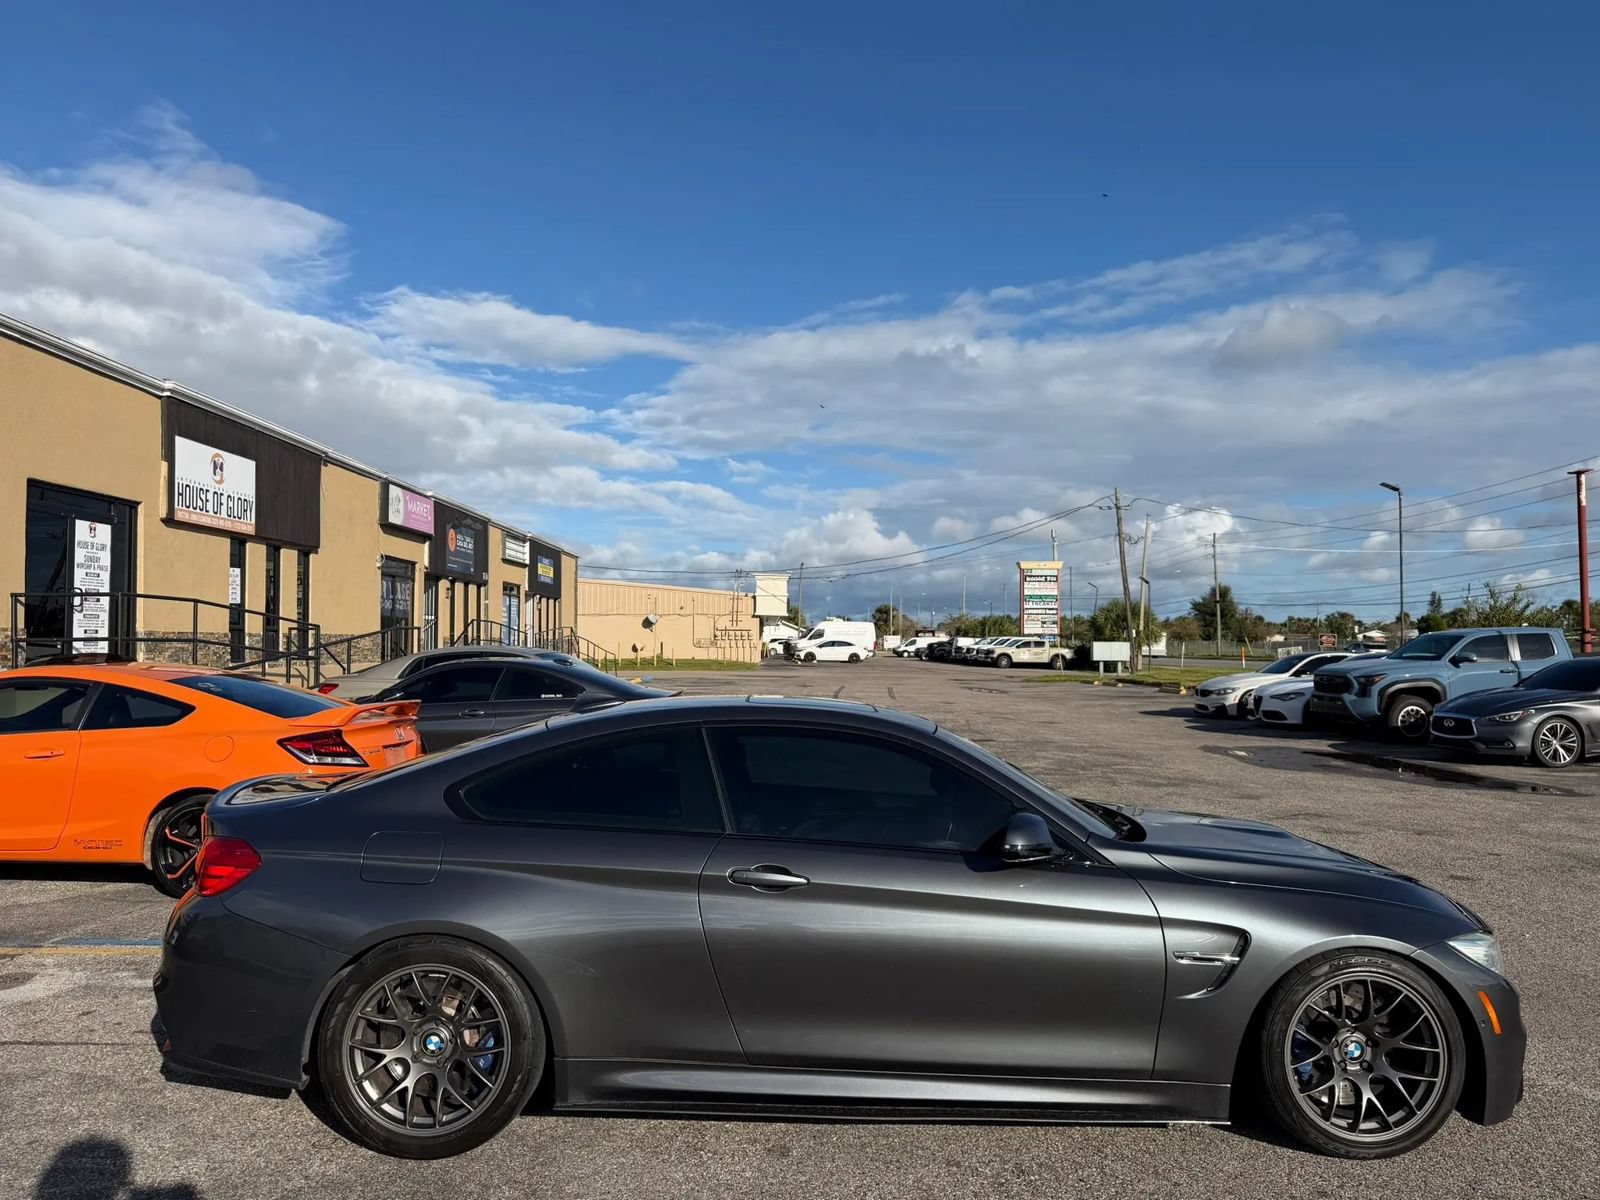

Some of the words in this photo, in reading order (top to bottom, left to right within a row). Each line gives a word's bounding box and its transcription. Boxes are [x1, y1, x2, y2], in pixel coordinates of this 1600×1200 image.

[177, 481, 210, 513] HOUSE
[213, 491, 224, 516] OF
[226, 494, 254, 522] GLORY
[407, 495, 431, 520] MARKET
[77, 540, 89, 550] HOUSE
[90, 542, 95, 550] OF
[96, 543, 107, 552] GLORY
[84, 554, 101, 564] SUNDAY
